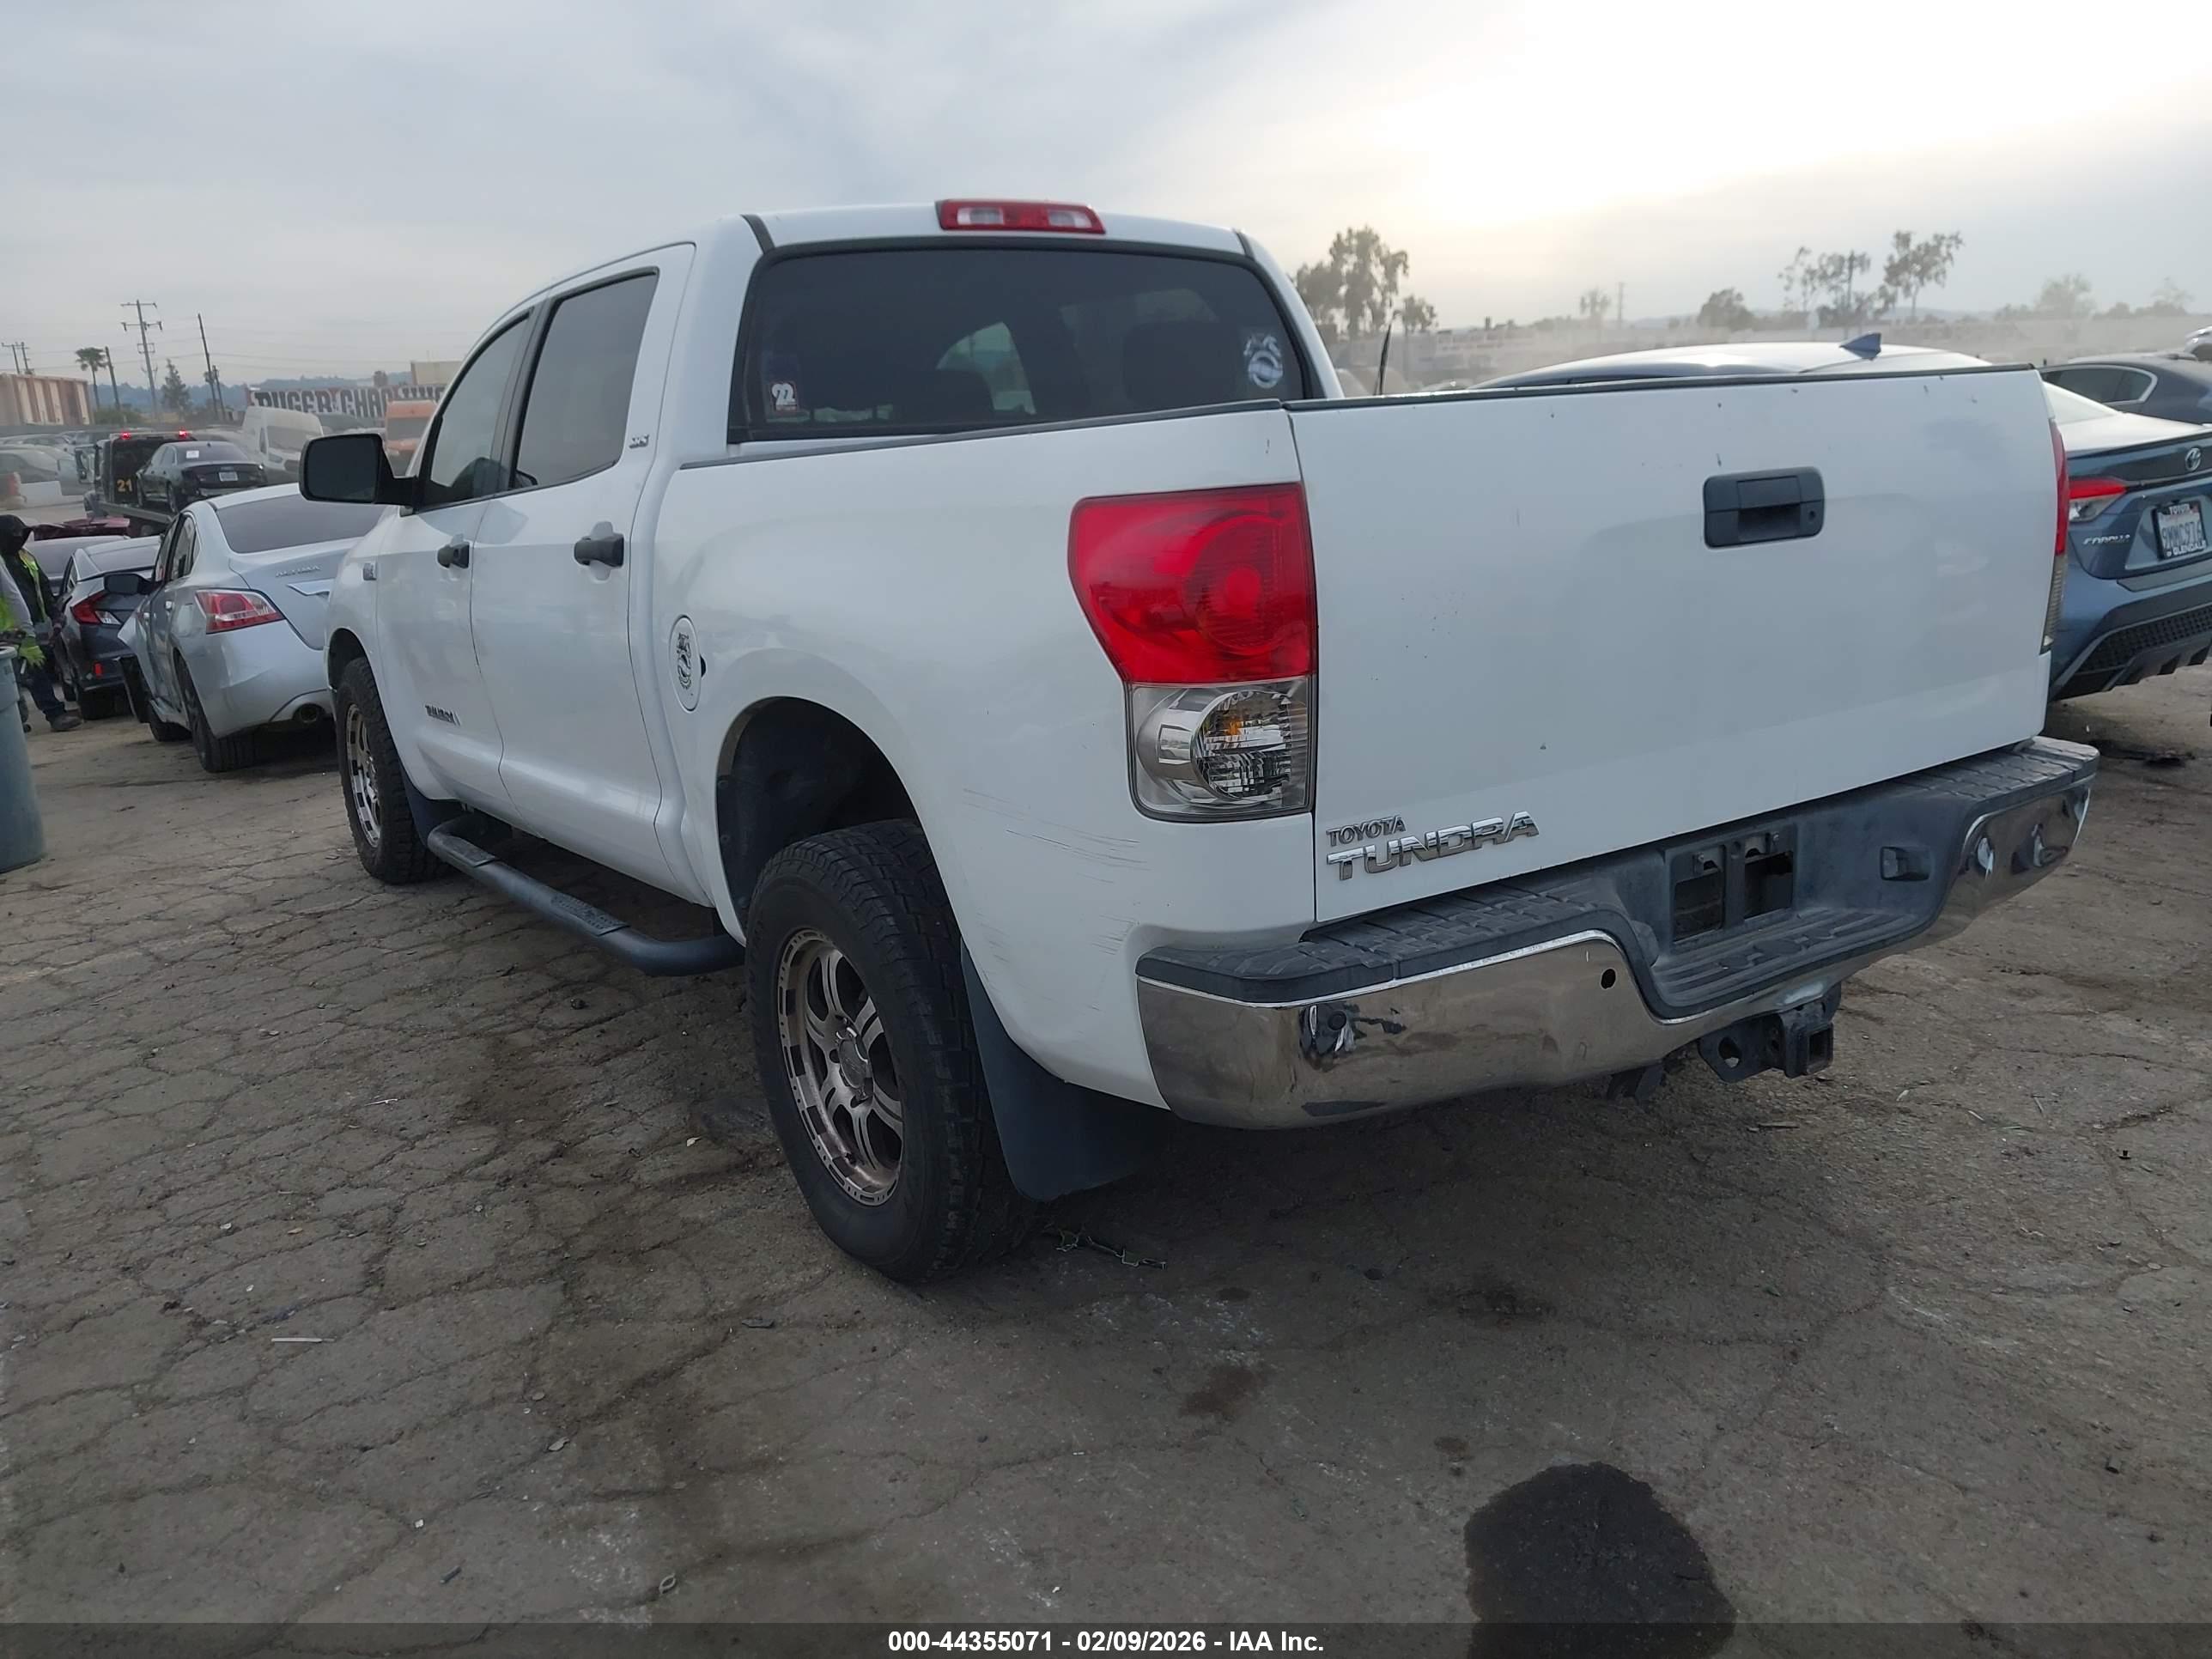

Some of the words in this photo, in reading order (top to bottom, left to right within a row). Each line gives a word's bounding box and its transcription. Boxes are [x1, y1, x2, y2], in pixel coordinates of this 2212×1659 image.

[117, 478, 133, 492] 21
[1326, 815, 1406, 846] TOYOTA
[1326, 811, 1540, 881] TUNDRA
